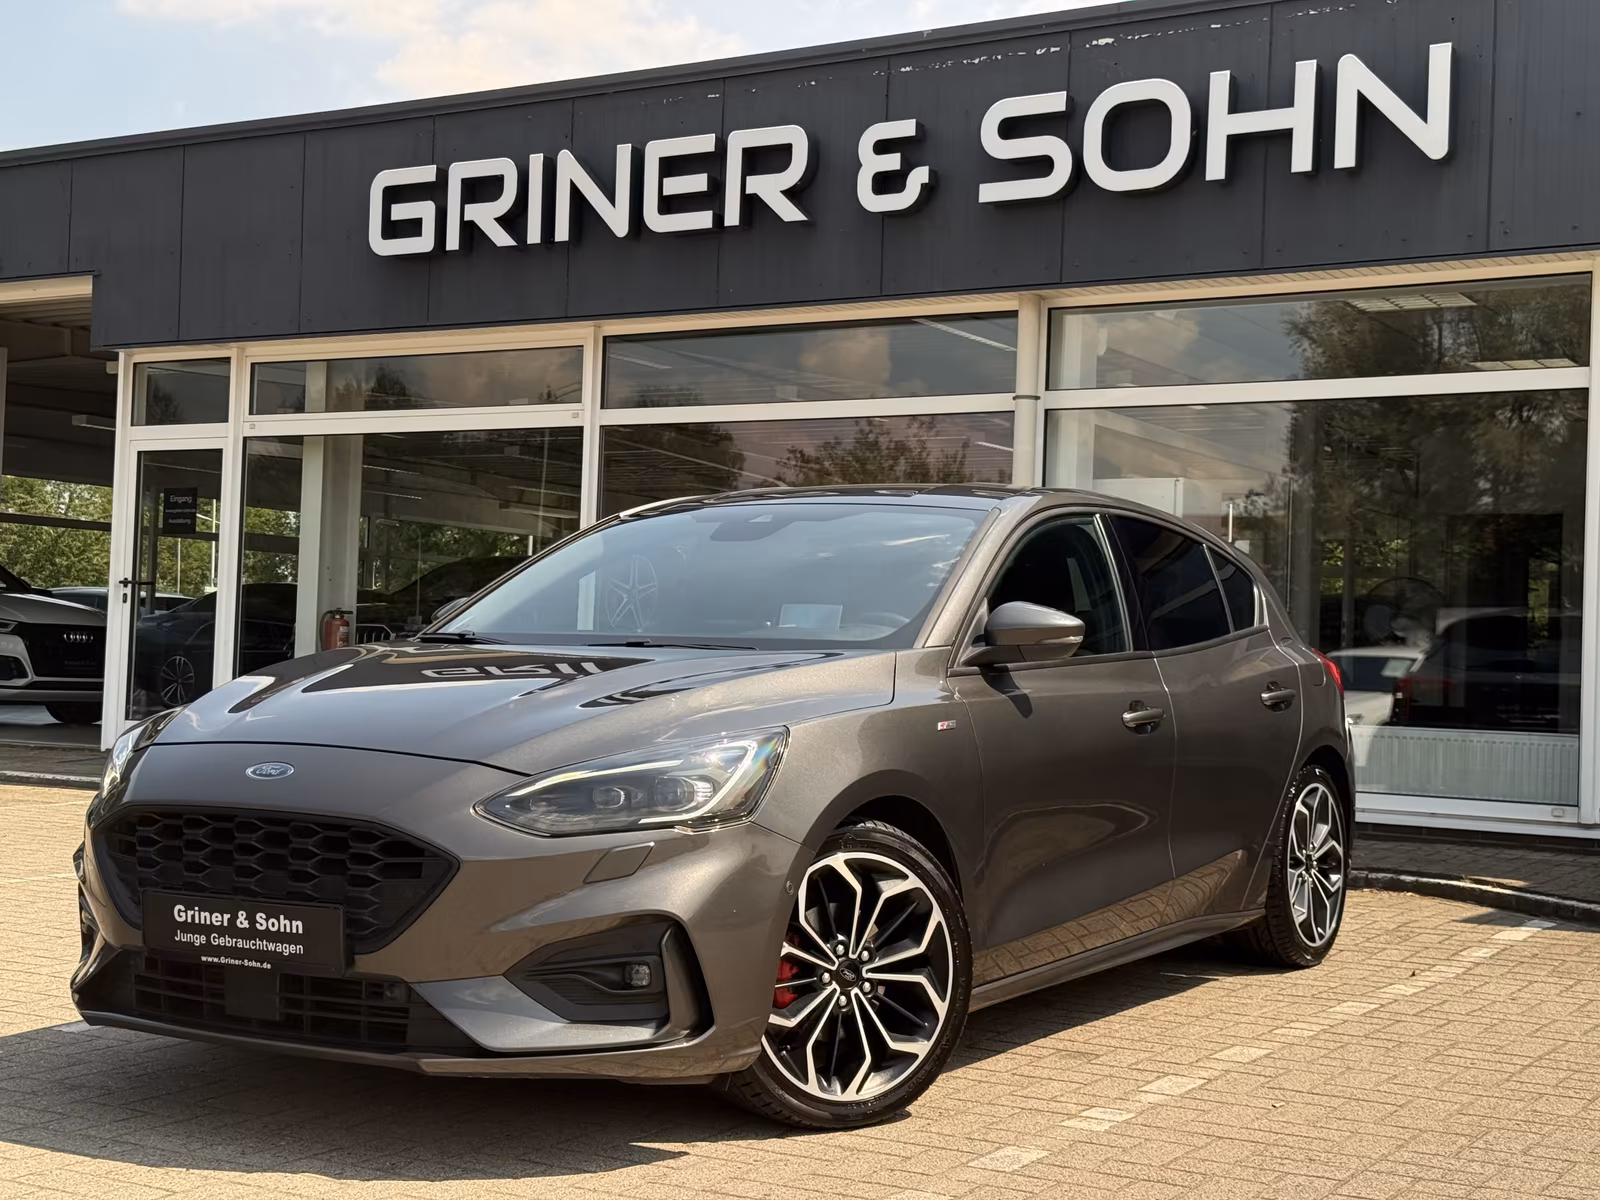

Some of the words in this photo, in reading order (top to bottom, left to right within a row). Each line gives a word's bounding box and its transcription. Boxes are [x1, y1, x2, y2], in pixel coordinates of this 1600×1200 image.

[368, 125, 809, 256] GRINER
[858, 119, 929, 213] &
[978, 42, 1453, 205] SOHN
[173, 904, 231, 926] Griner
[236, 910, 250, 928] &
[255, 912, 303, 934] Sohn
[174, 929, 207, 946] Junge
[210, 933, 304, 956] Gebrauchtwagen
[201, 955, 272, 970] www.Griner-Sohn.de
